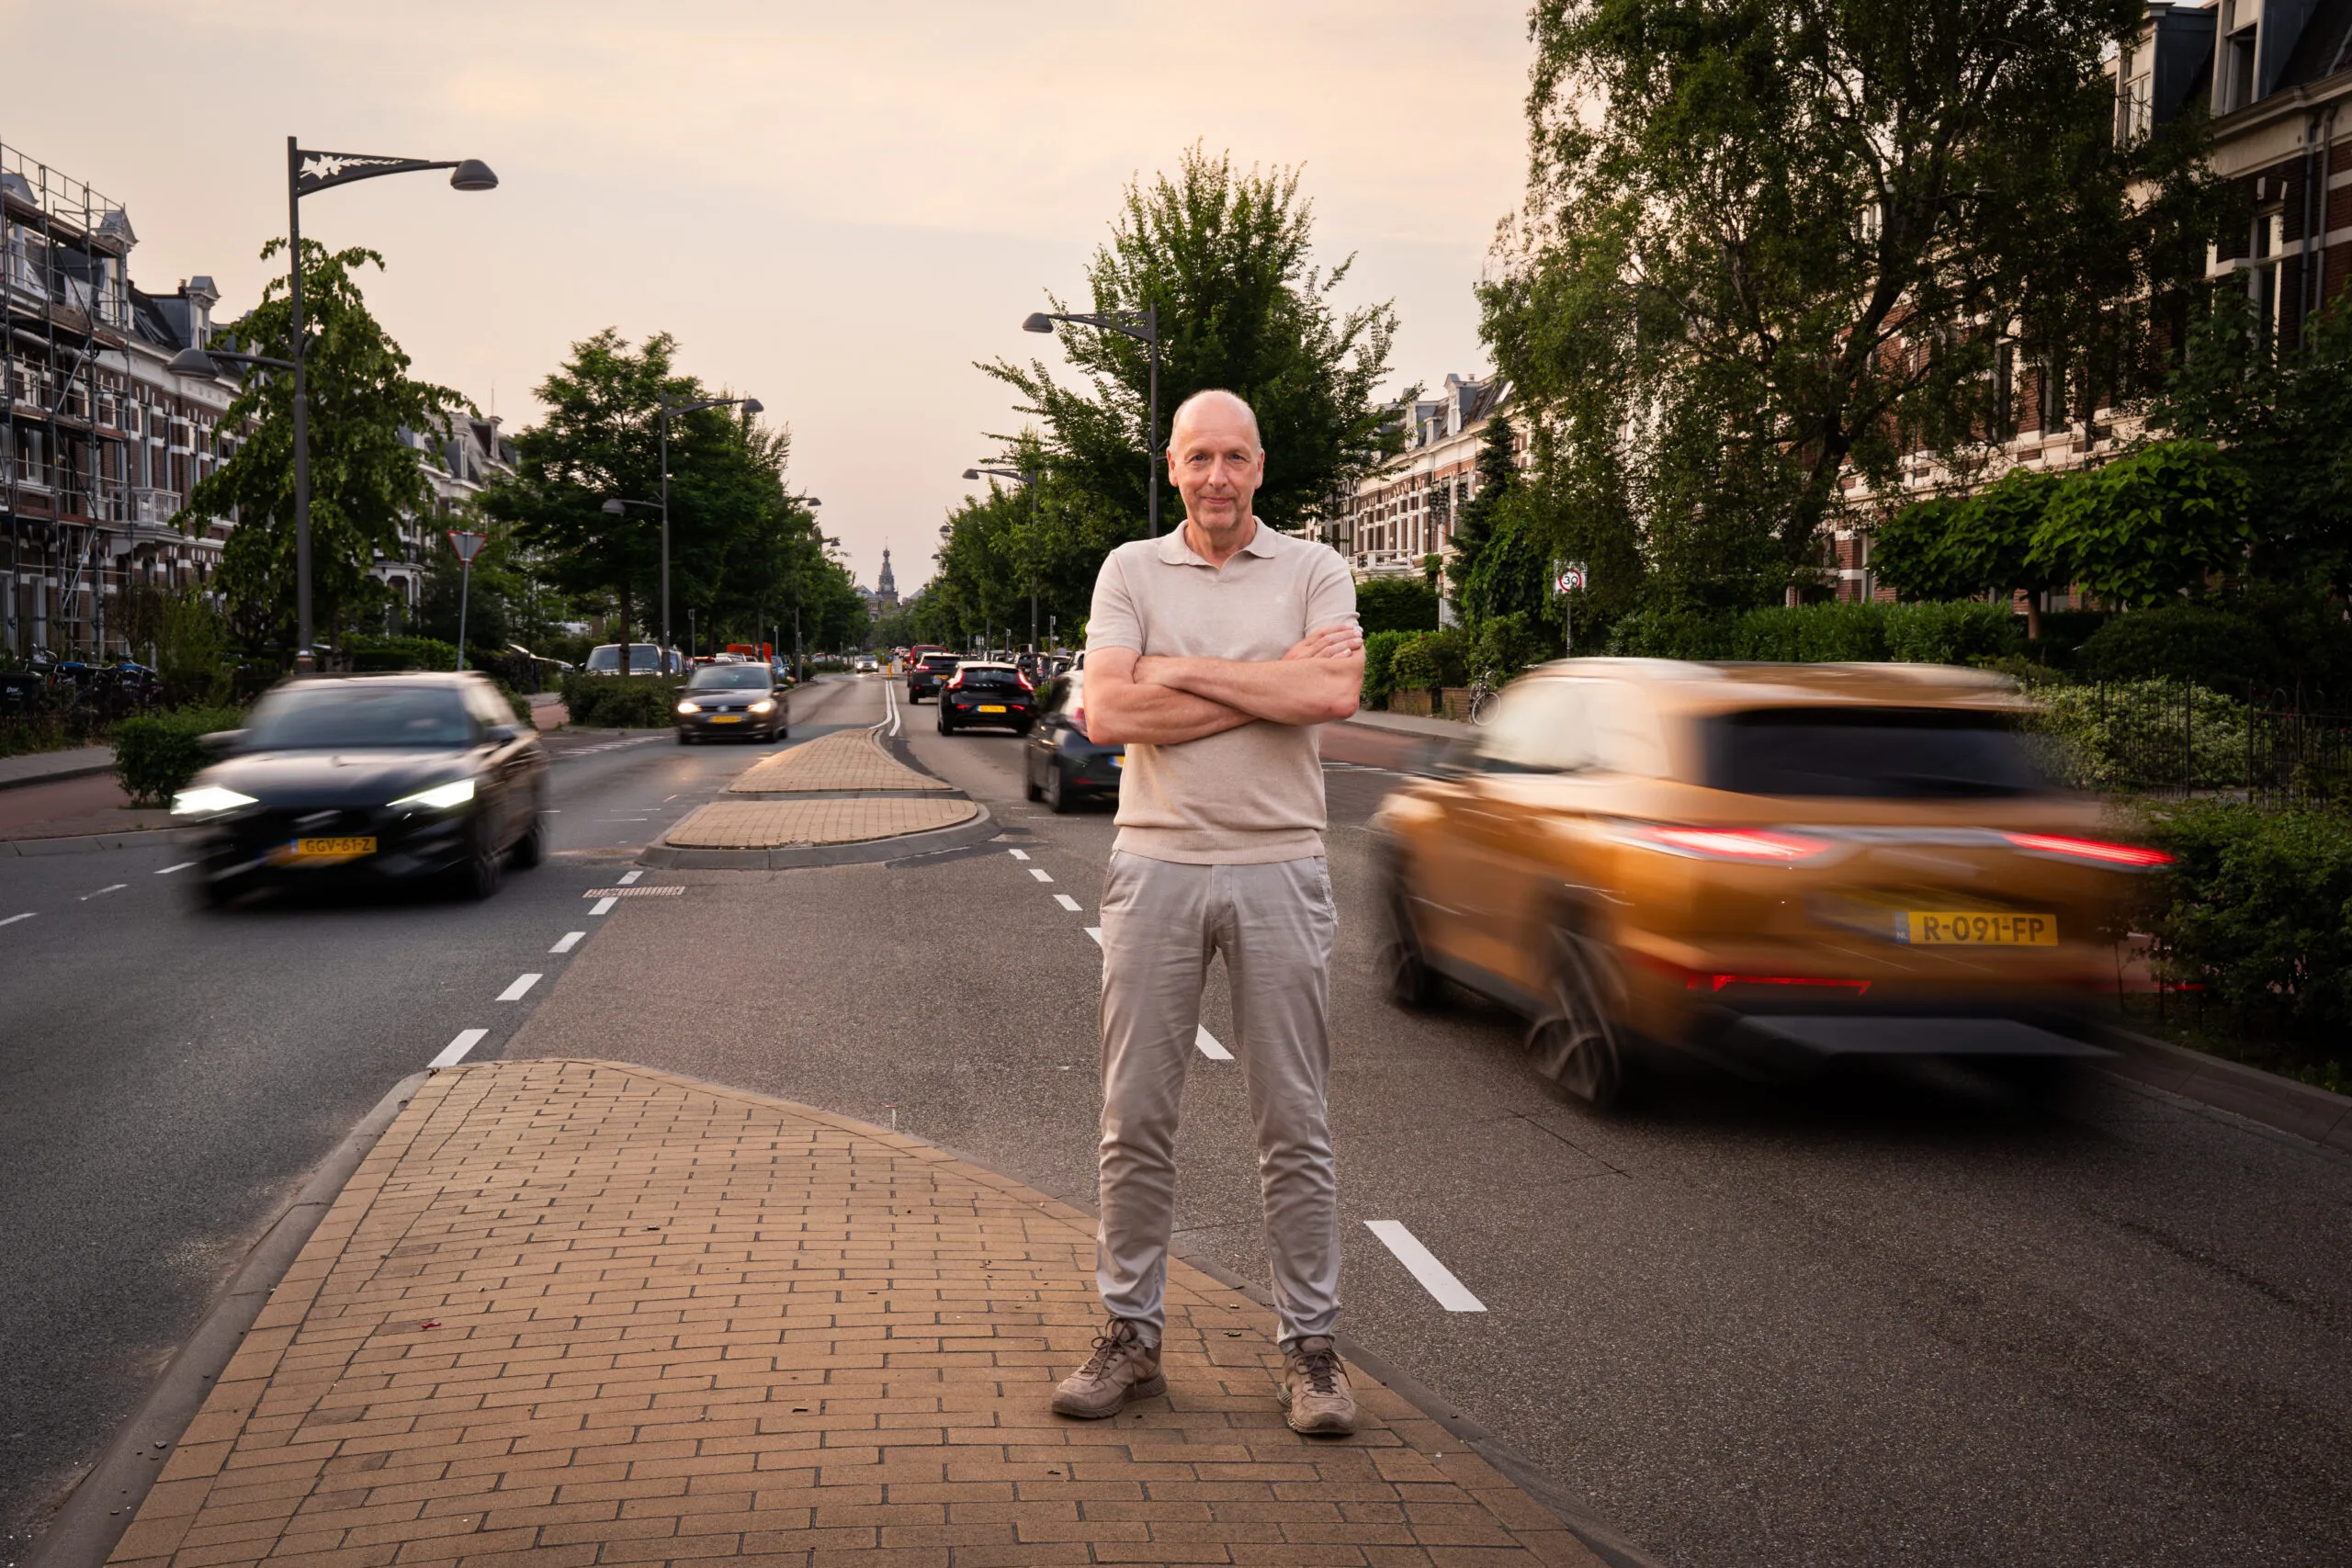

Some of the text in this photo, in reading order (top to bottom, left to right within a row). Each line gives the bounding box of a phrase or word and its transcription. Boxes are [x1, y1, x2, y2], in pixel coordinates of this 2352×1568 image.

[1563, 575, 1578, 585] 30
[305, 839, 371, 852] GGV-61-Z
[1896, 916, 2044, 942] NL R-091-FP
